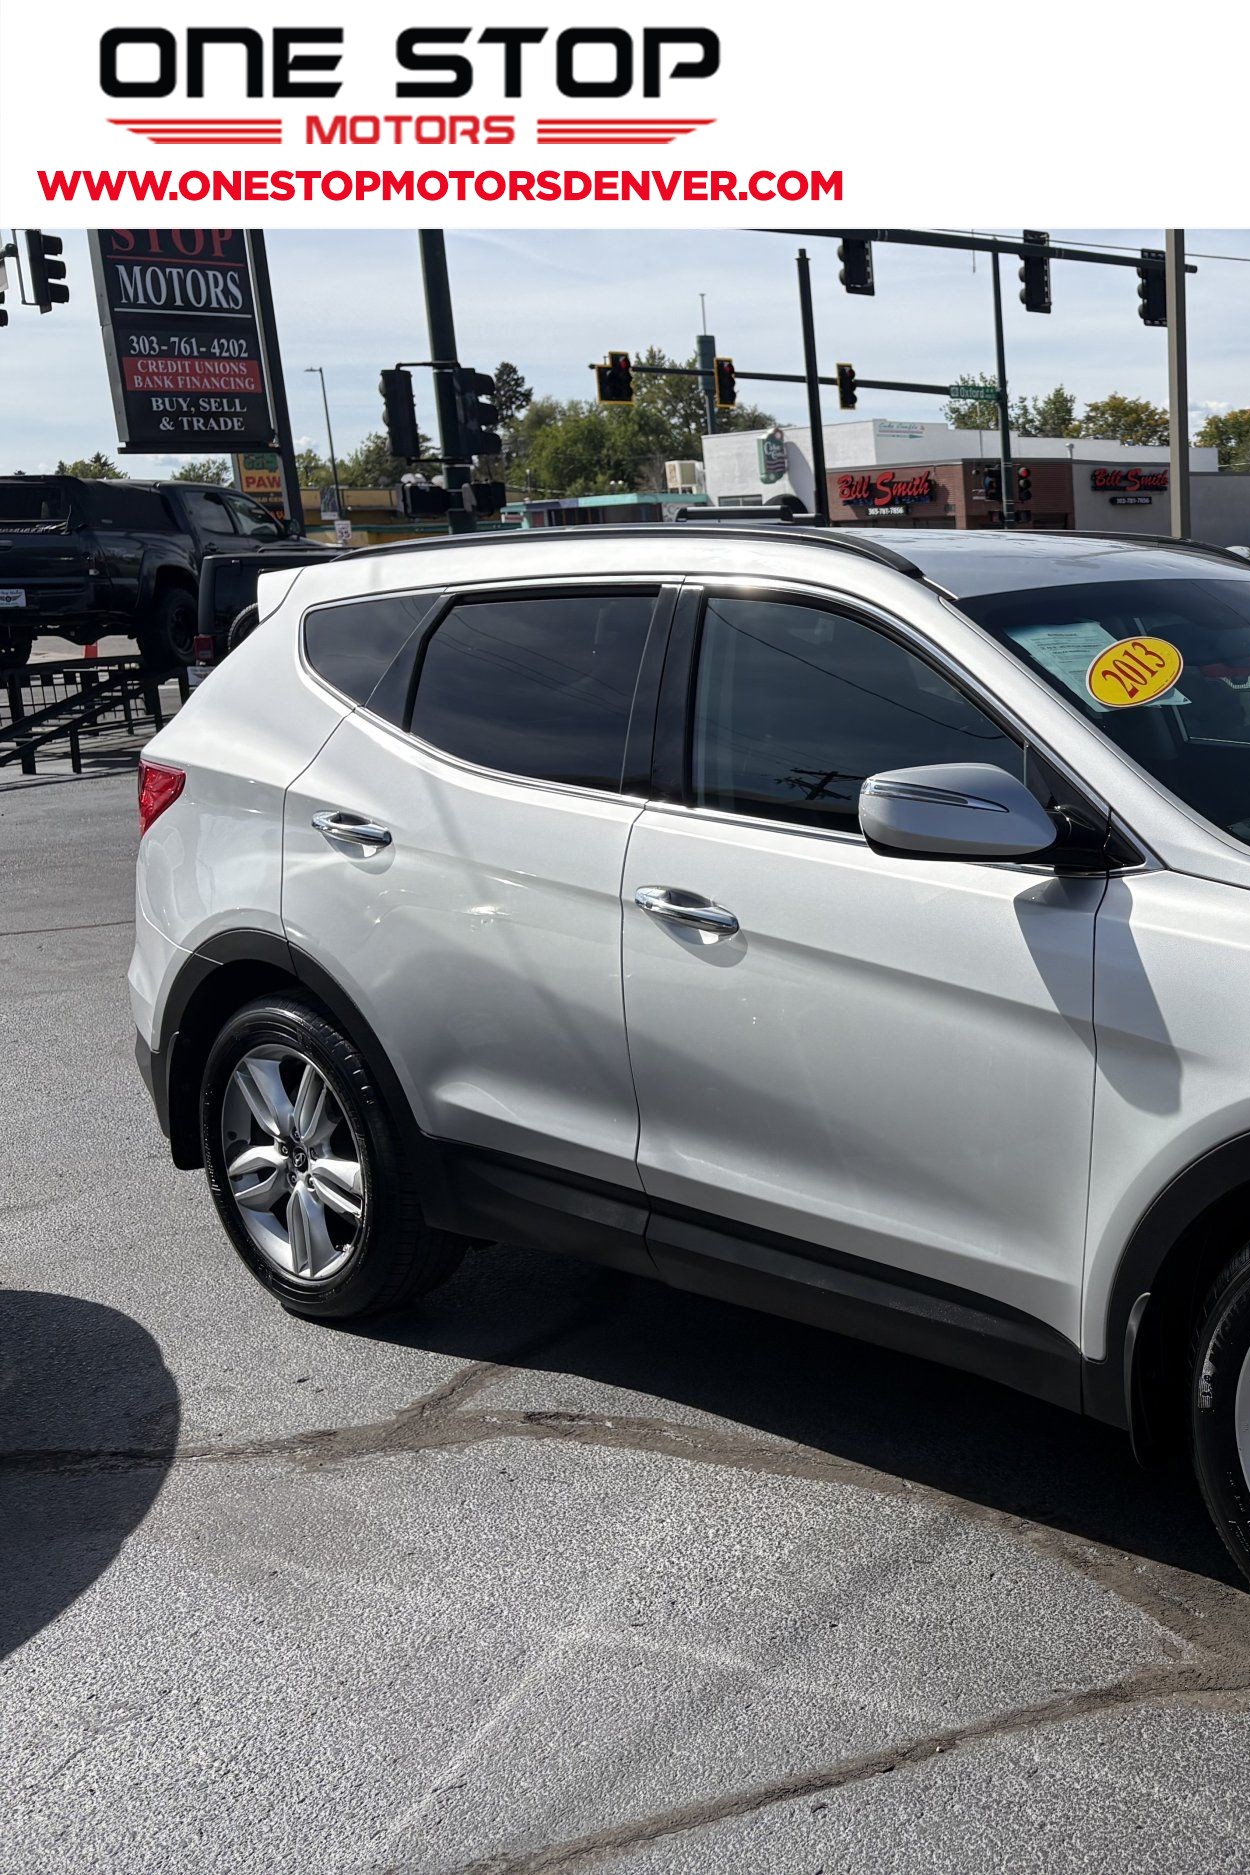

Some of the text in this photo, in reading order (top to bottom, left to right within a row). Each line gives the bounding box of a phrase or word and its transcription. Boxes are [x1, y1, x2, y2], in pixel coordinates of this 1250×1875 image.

[111, 229, 232, 257] STOP
[115, 264, 243, 310] MOTORS
[137, 360, 247, 375] CREDIT UNIONS
[134, 375, 255, 390] BANK FINANCING
[150, 397, 247, 413] BUY, SELL
[160, 416, 245, 431] & TRADE
[838, 470, 930, 506] Bill Smith
[1094, 468, 1168, 491] Bill Smith
[1101, 641, 1166, 699] 2013
